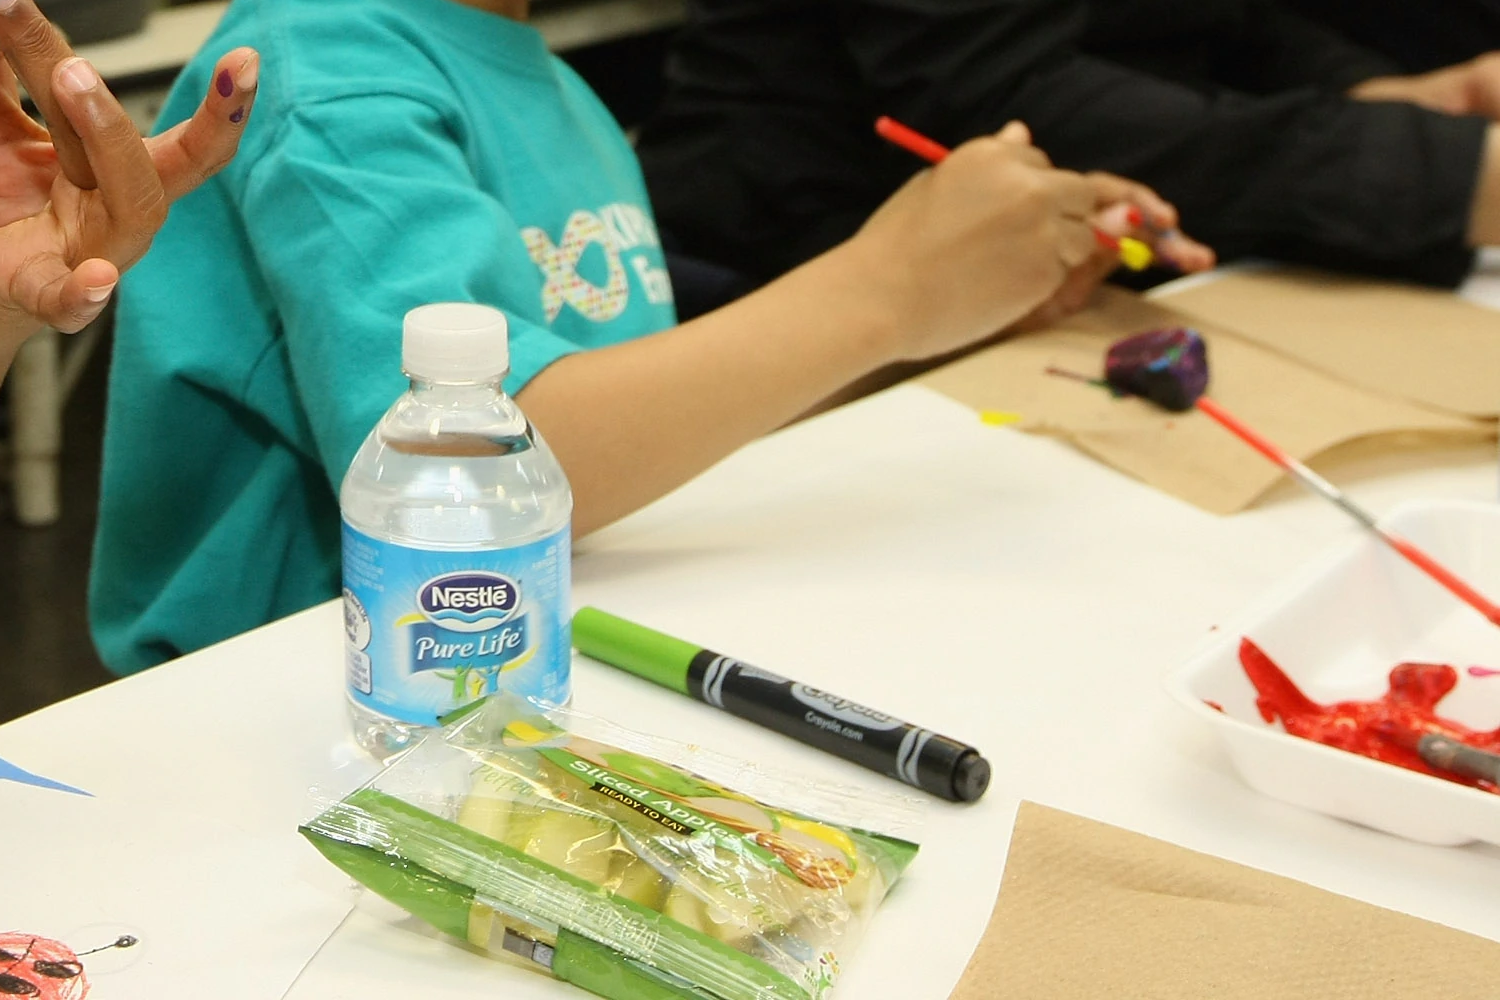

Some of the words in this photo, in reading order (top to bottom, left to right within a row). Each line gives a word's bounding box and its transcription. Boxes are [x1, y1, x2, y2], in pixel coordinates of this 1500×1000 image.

[431, 584, 508, 608] Nestlé
[415, 636, 476, 660] Pure
[477, 627, 521, 656] Life
[804, 710, 864, 742] Crayola.com
[568, 759, 650, 799] Sliced
[599, 785, 642, 809] READY
[642, 805, 660, 820] TO
[660, 816, 687, 834] EAT
